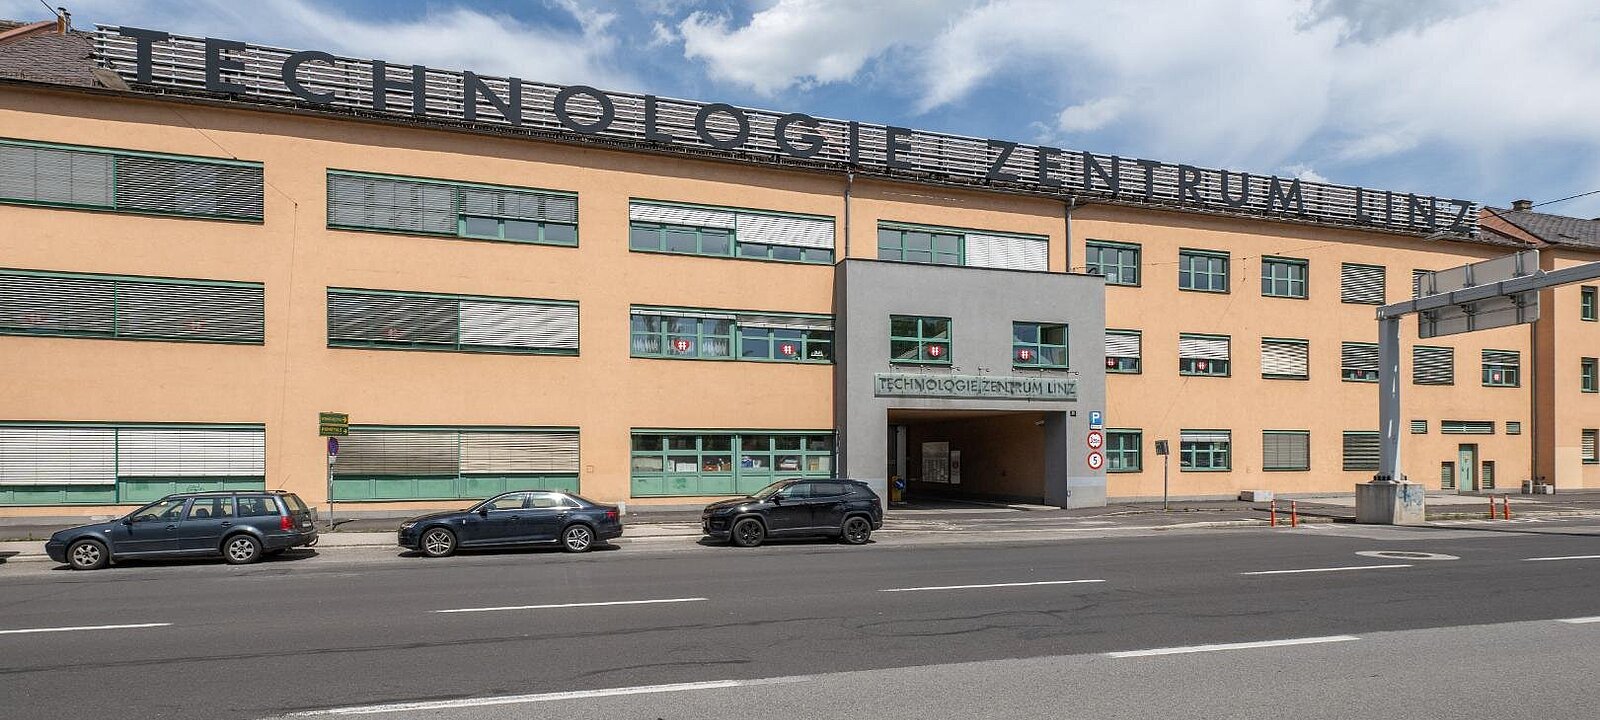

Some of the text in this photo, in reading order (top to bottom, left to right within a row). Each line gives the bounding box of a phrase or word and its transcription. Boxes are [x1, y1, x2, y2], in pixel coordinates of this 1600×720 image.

[119, 26, 1475, 233] TECHNOLOGIE ZENTRUM LINZ
[879, 377, 1076, 395] TECHNOLOGIE ZENTRUM LINZ
[1092, 412, 1100, 424] P
[1093, 456, 1098, 466] 5
